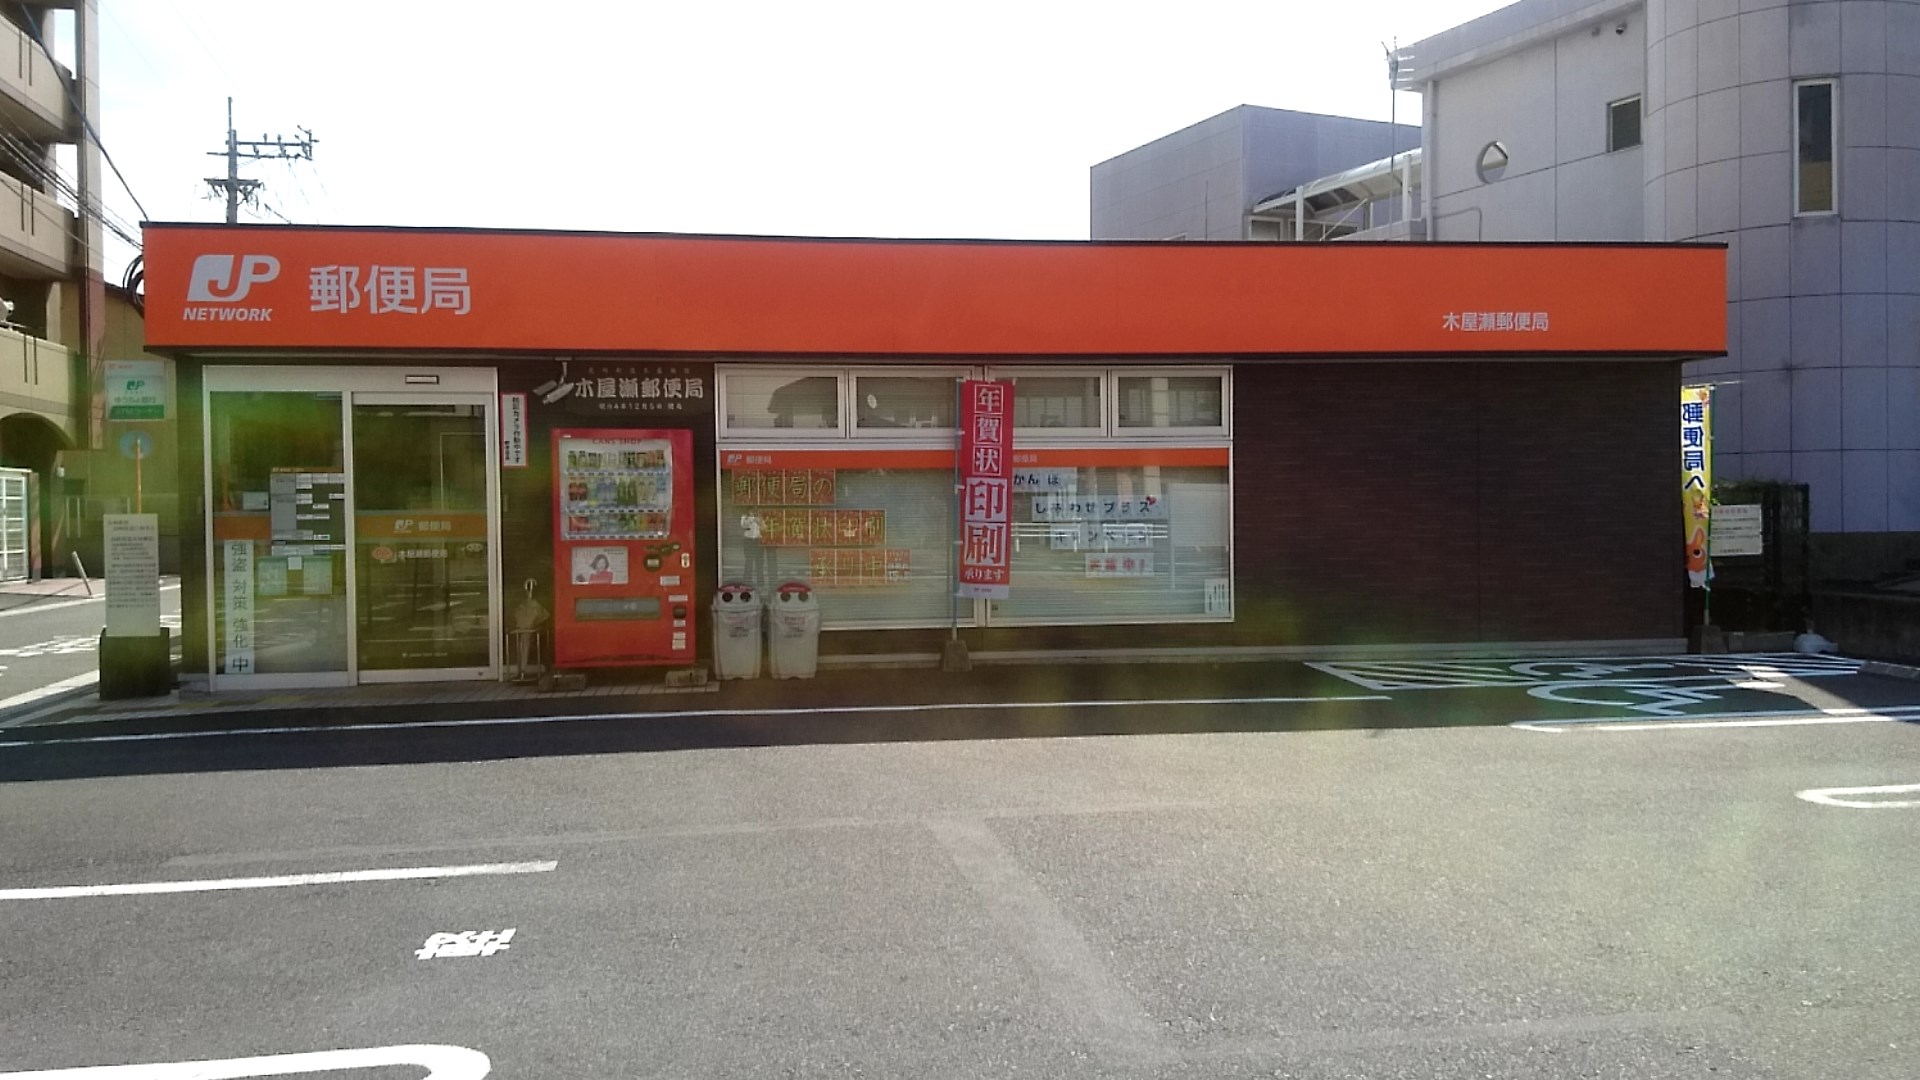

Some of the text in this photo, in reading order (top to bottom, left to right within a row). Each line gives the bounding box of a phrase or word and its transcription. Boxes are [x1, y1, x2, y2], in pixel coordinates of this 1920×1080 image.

[187, 254, 281, 302] JP
[309, 265, 472, 316] 郵便局
[183, 306, 272, 322] NETWORK
[1442, 311, 1550, 332] 木屋瀬郵便局
[575, 377, 704, 399] 木屋瀬郵便局
[735, 475, 833, 501] 郵便局の
[763, 515, 885, 541] 年賀状印刷
[964, 567, 1005, 581] 承ります
[231, 541, 250, 673] 強盗対策強化中
